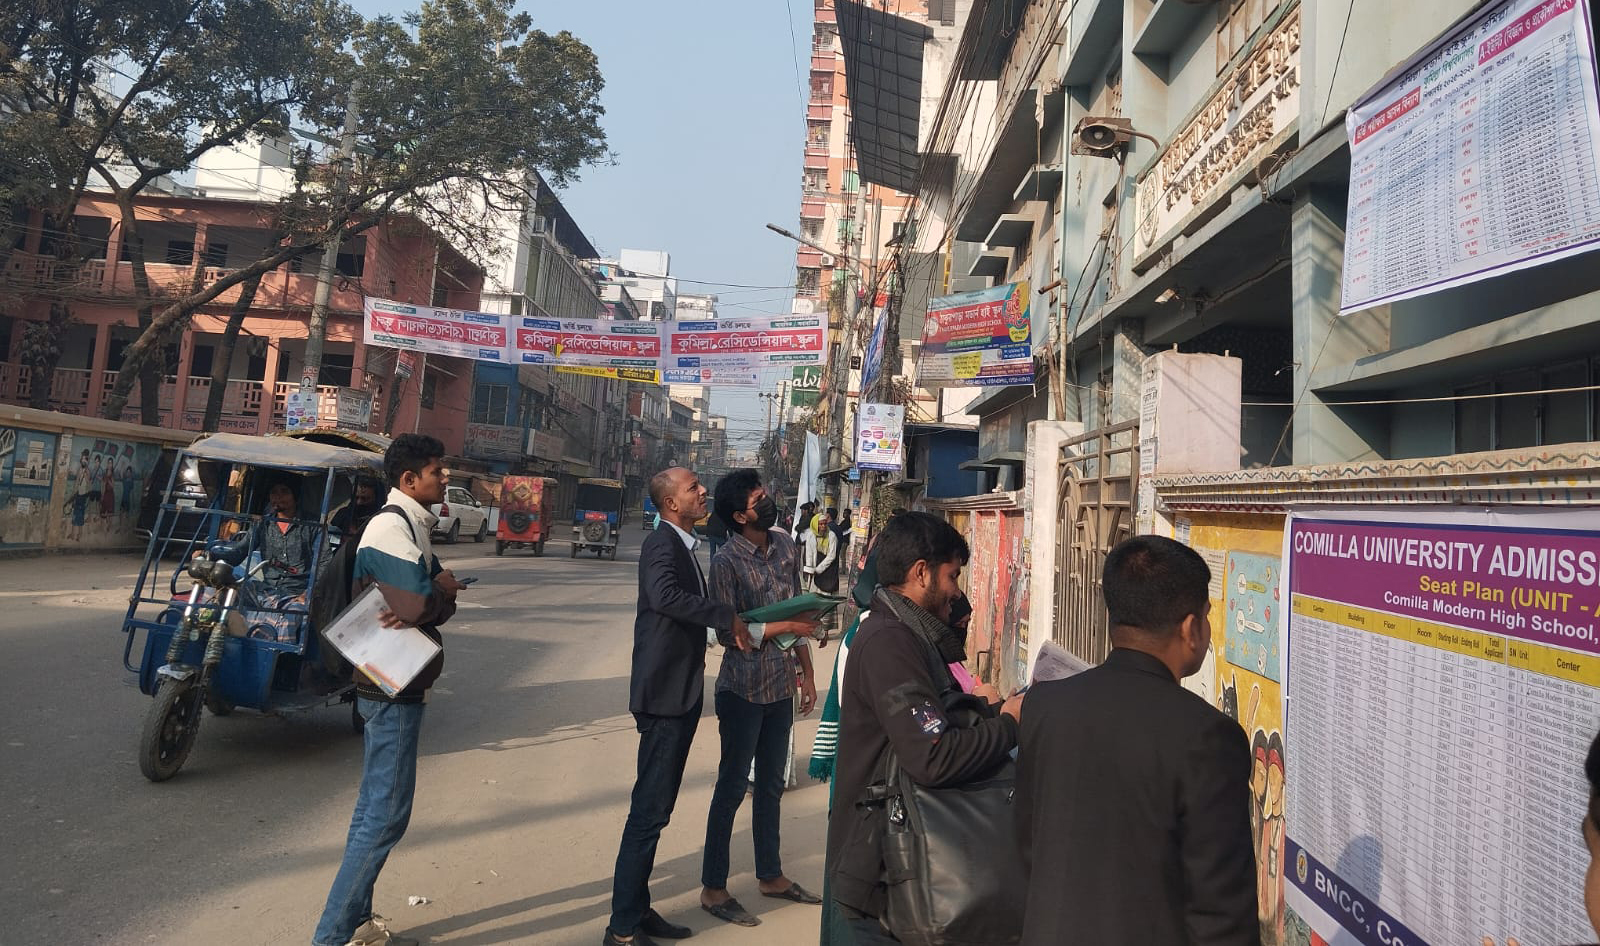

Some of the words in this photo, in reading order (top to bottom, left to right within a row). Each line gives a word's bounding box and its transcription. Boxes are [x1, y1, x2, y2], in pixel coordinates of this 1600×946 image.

[678, 333, 714, 352] কুমিল্লা
[796, 333, 818, 350] স্কুল
[1294, 530, 1359, 560] COMILLA
[1363, 536, 1484, 575] UNIVERSITY
[1488, 544, 1600, 587] ADMISS
[1419, 575, 1457, 596] Seat
[1463, 580, 1504, 603] Plan
[1511, 586, 1574, 613] (UNIT
[1384, 591, 1429, 610] Comilla
[1432, 597, 1485, 620] Modern
[1490, 606, 1526, 630] High
[1531, 615, 1599, 644] School,
[1416, 627, 1432, 639] Room
[1488, 637, 1500, 648] Total
[1556, 658, 1580, 672] Center
[1314, 869, 1371, 934] BNCC,
